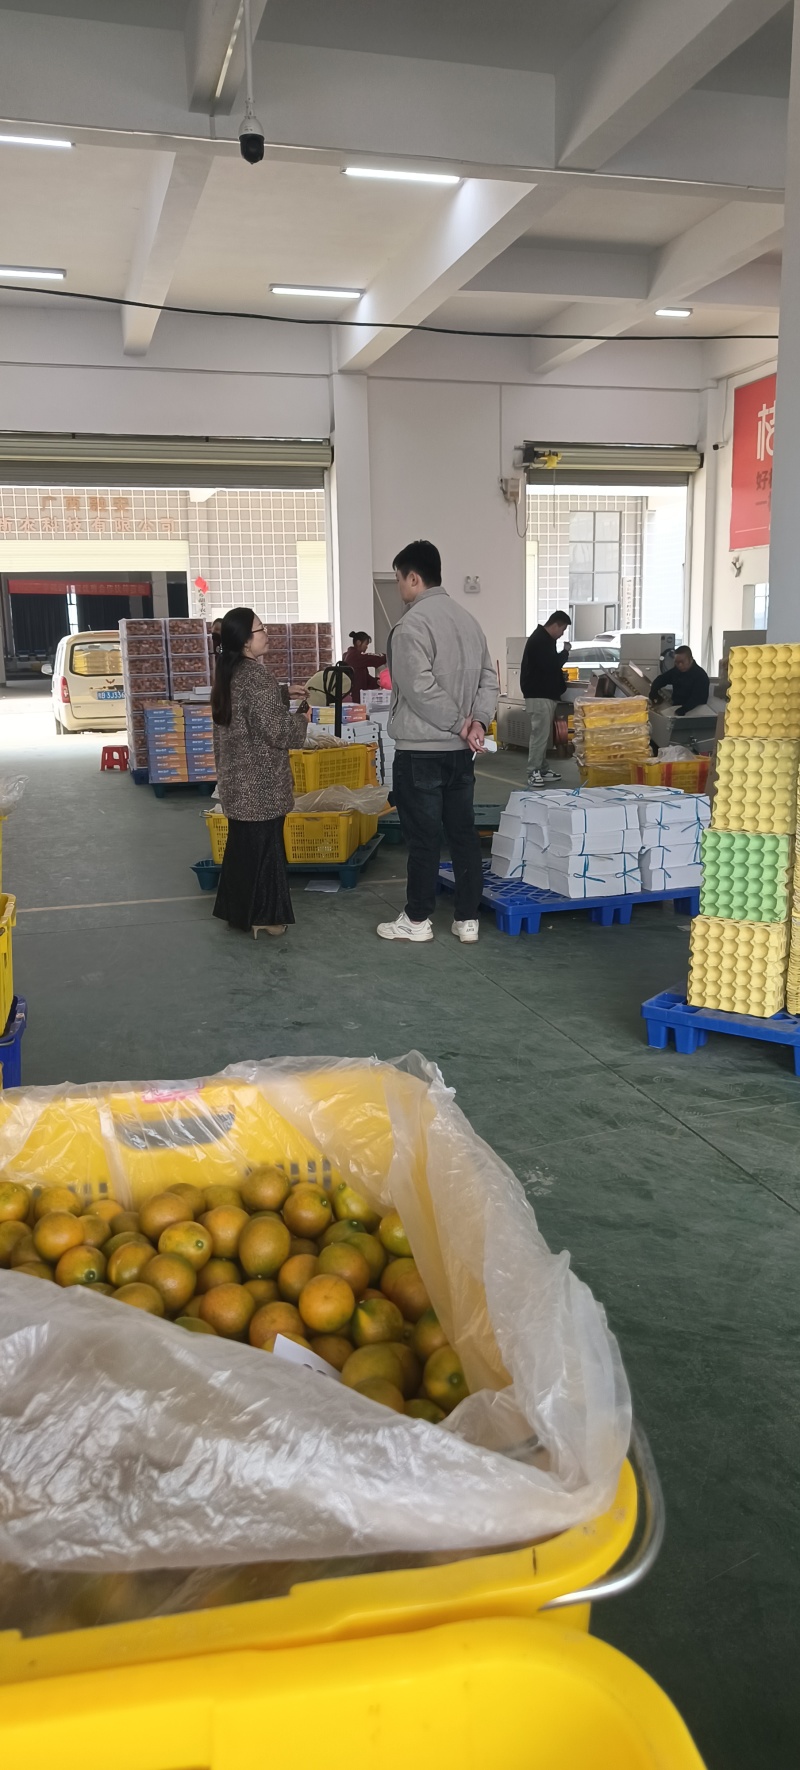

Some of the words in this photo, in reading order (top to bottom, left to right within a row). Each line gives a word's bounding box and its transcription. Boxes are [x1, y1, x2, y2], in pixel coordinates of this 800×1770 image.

[756, 468, 772, 490] 好
[40, 495, 129, 512] 广西融安
